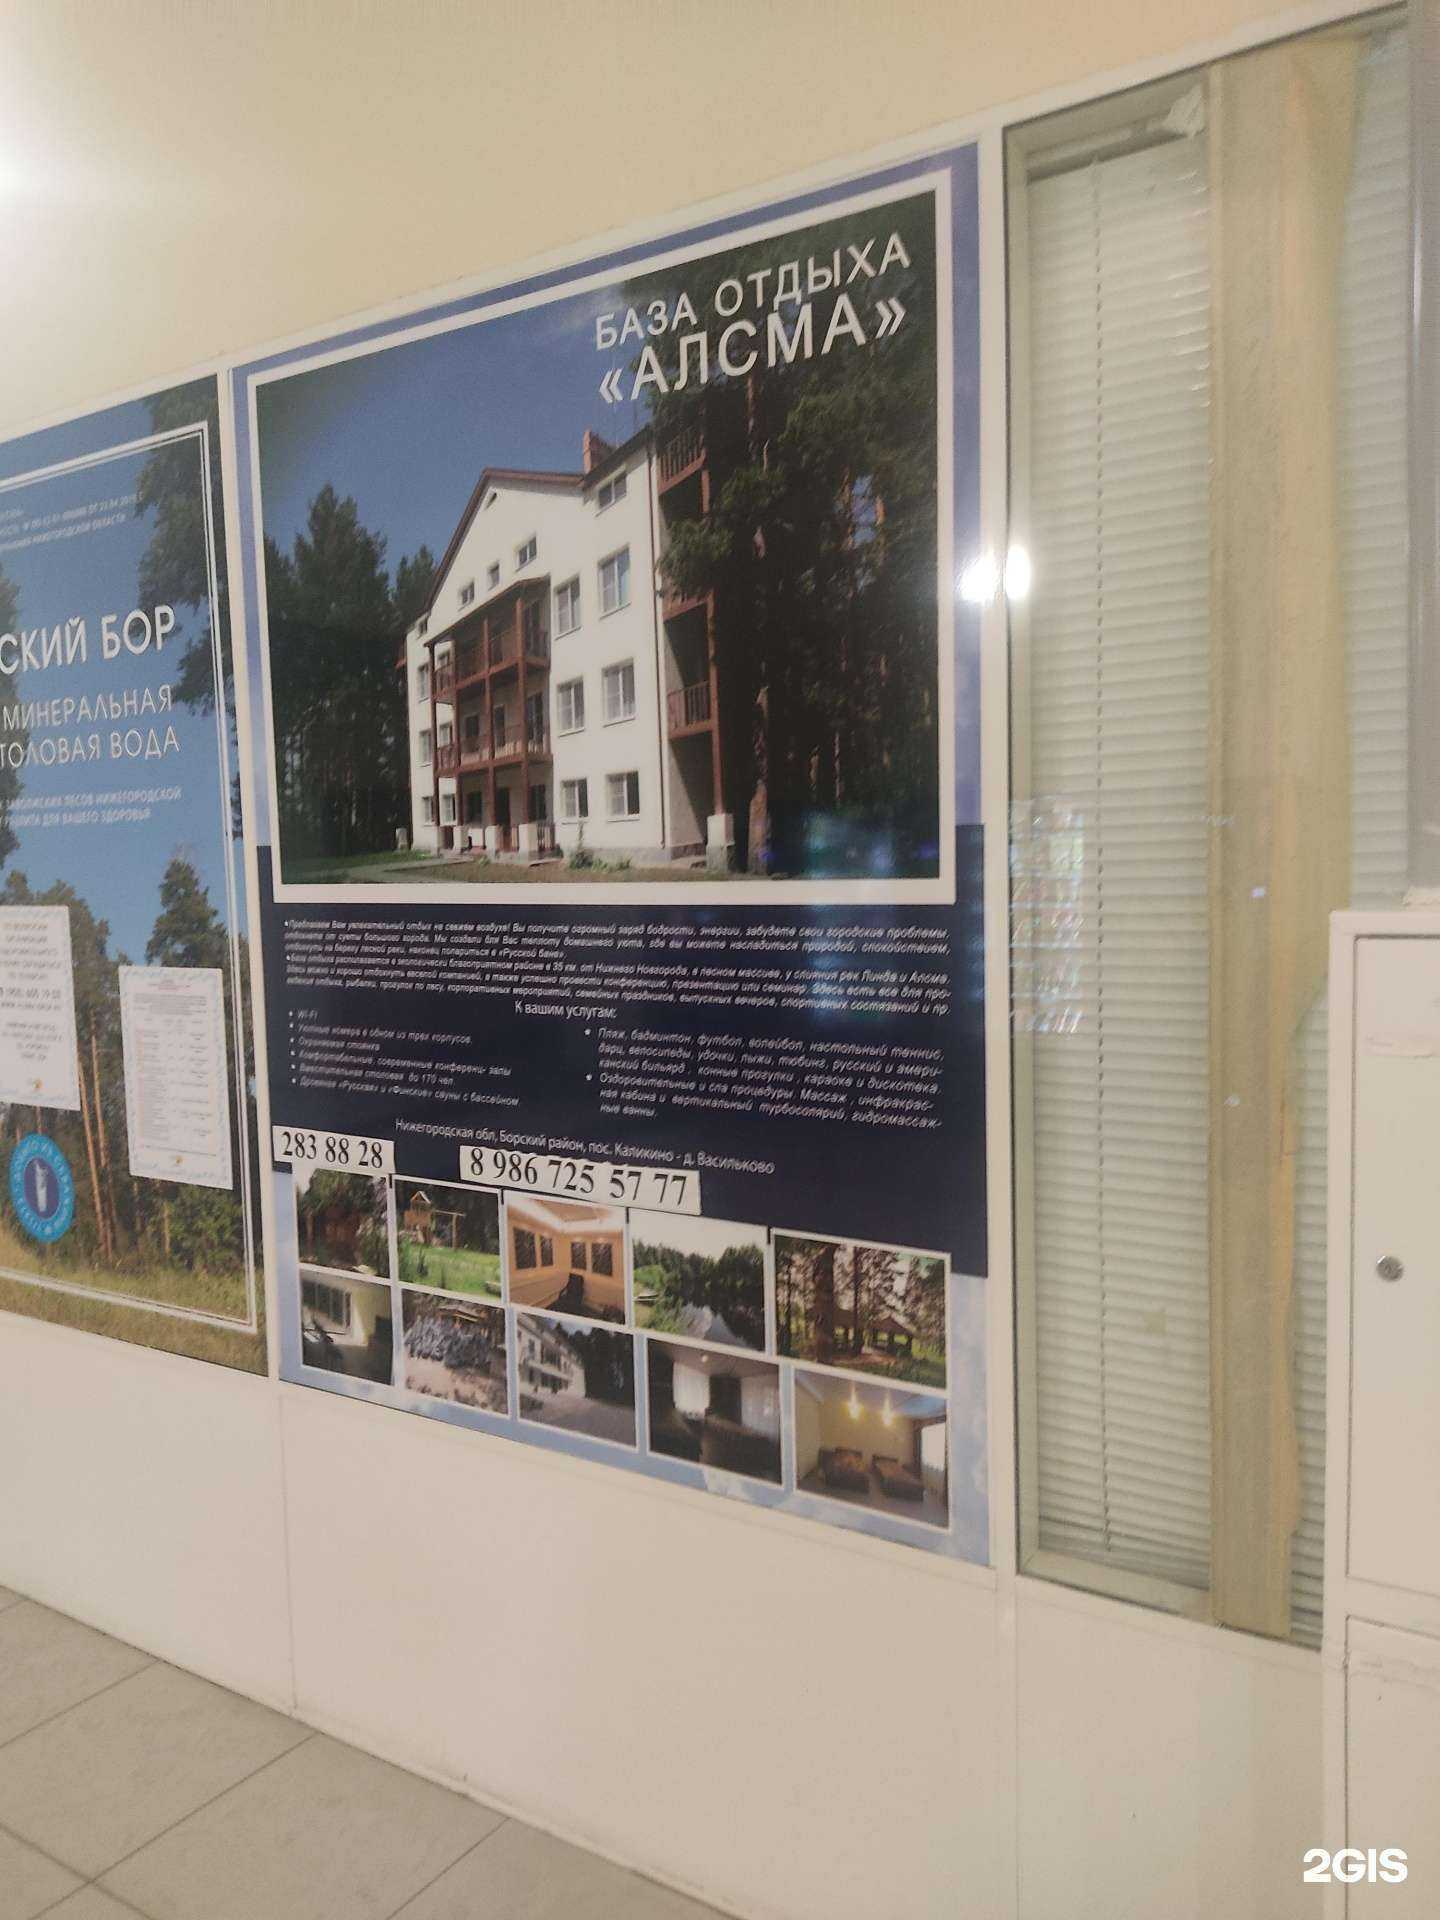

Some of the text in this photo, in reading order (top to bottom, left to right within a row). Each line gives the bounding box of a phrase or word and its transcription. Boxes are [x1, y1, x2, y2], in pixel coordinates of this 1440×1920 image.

[596, 231, 911, 351] БАЗА ОТДЫХА
[599, 292, 907, 404] «АЛСМА»
[0, 605, 175, 674] СКИЙ БОР
[3, 685, 172, 731] МИНЕРАЛЬНАЯ
[110, 726, 180, 760] ВОДА
[282, 1130, 383, 1168] 283 88 28
[470, 1148, 687, 1206] 8 986 725 57 77
